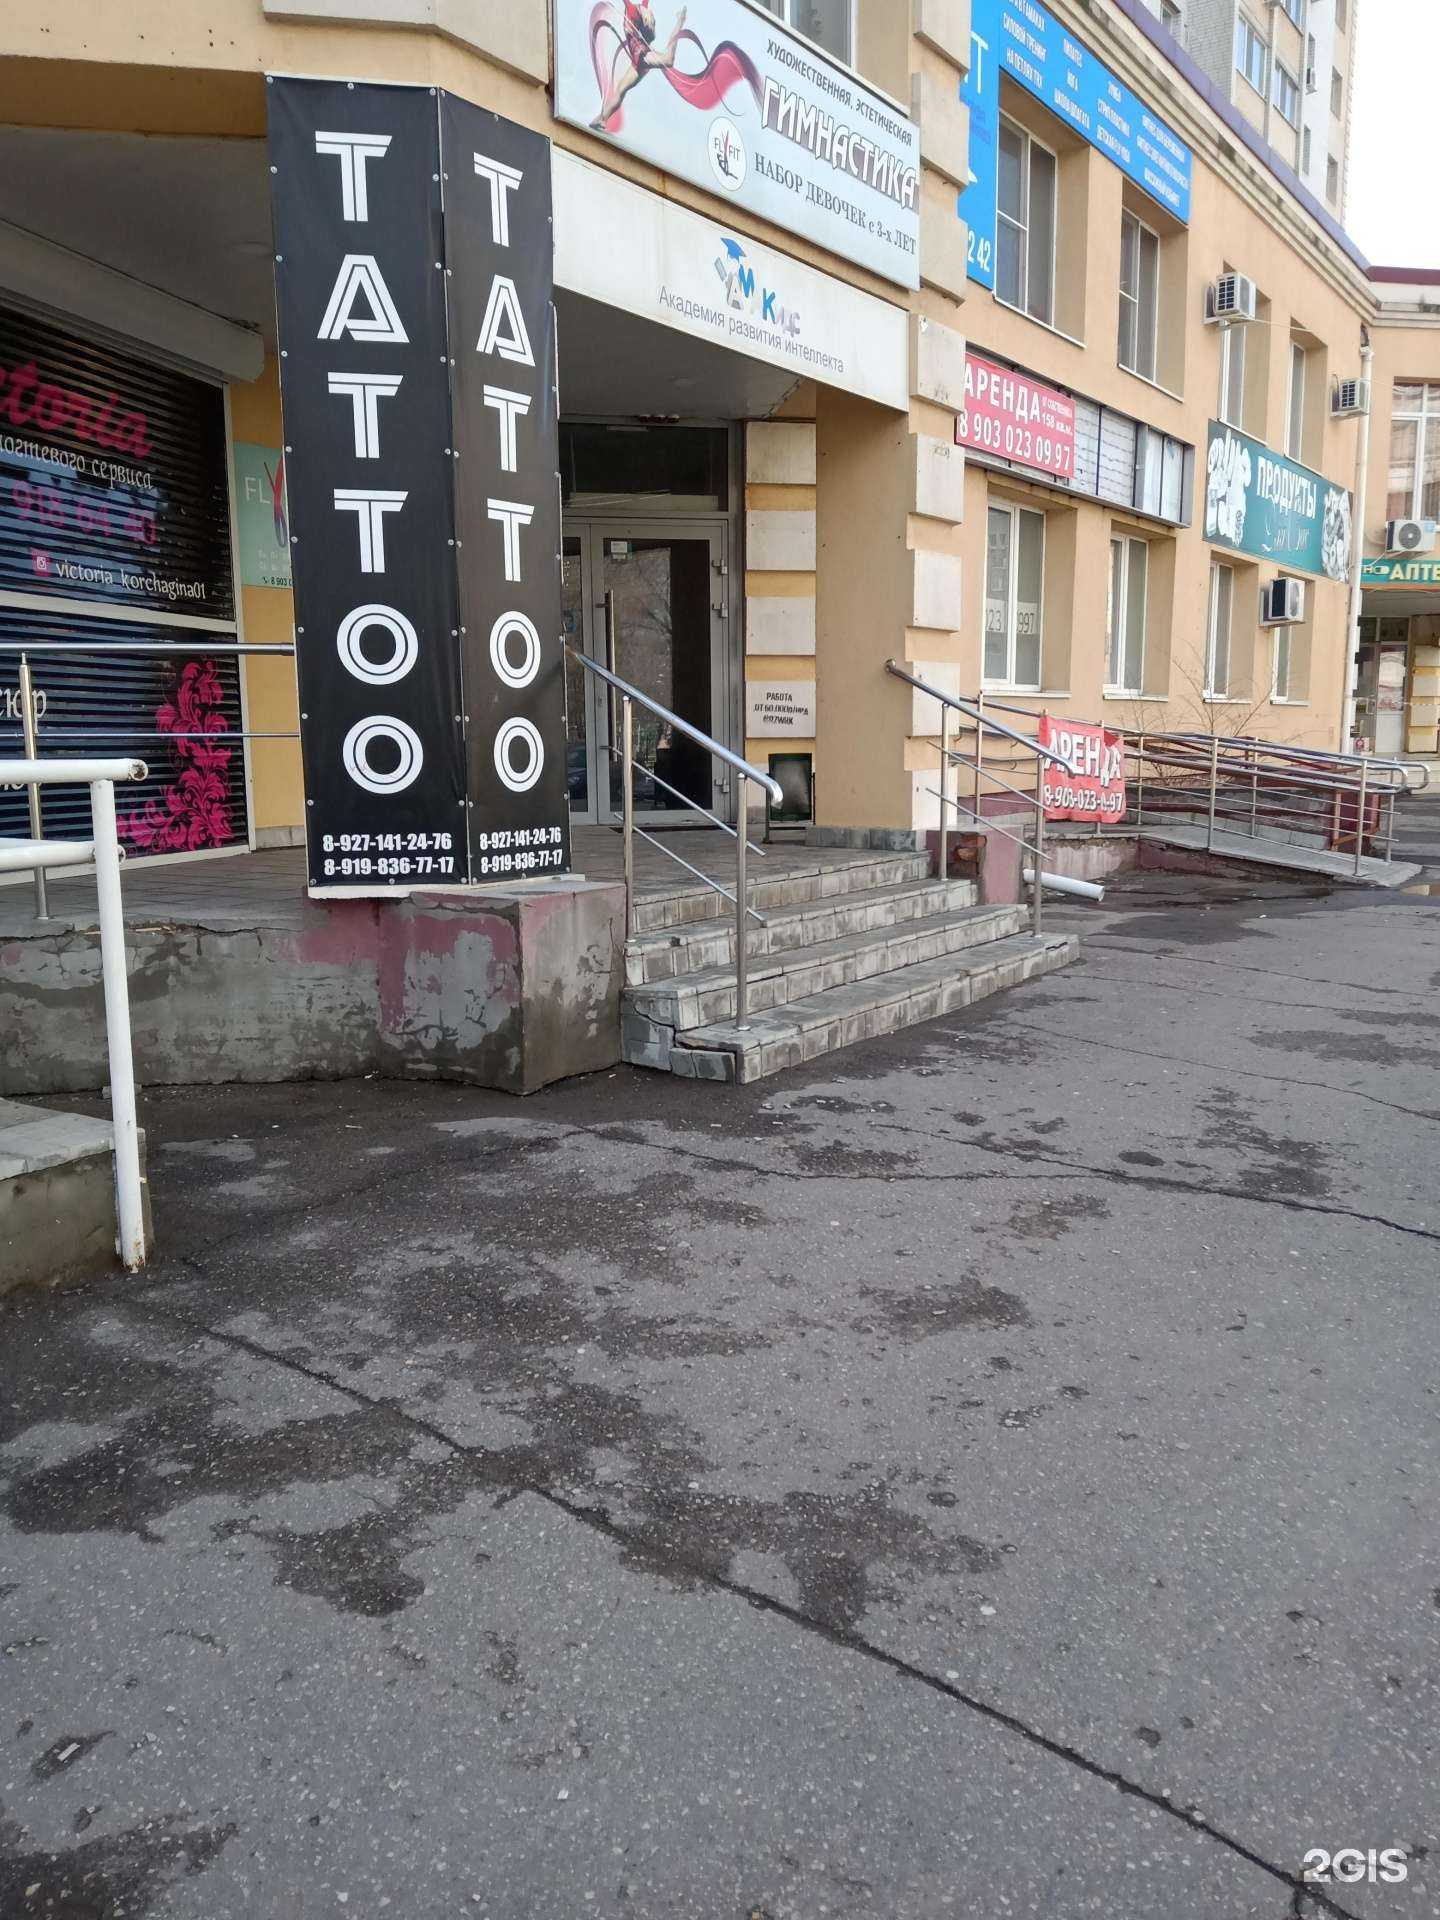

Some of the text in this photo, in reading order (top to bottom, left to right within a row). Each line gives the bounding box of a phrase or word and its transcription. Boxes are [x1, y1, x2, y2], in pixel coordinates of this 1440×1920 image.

[767, 38, 853, 110] ХУДОЖЕСТВЕННАЯ,
[856, 98, 912, 147] ЭСТЕТИЧЕСКАЯ
[761, 75, 919, 210] ГИМНАСТИКА
[754, 152, 803, 193] НАБОР
[805, 180, 867, 229] ДЕВОЧЕК
[876, 220, 892, 243] 3-х
[894, 229, 916, 255] ЛЕТ
[977, 237, 991, 272] 42
[658, 285, 844, 373] Академия развития интеллекта
[963, 362, 1041, 425] АРЕНДА
[959, 408, 1071, 471] 8 903 023 09 97
[91, 458, 153, 489] сервиса
[1256, 455, 1317, 520] ПРОДУКТЫ
[766, 691, 793, 703] РАБОТА
[322, 832, 452, 852] 8-927-141-24-76
[479, 826, 562, 850] 8-927-141-24-76
[480, 849, 563, 874] 8-919-836-77-17
[323, 856, 455, 876] 8-919-836-77-17
